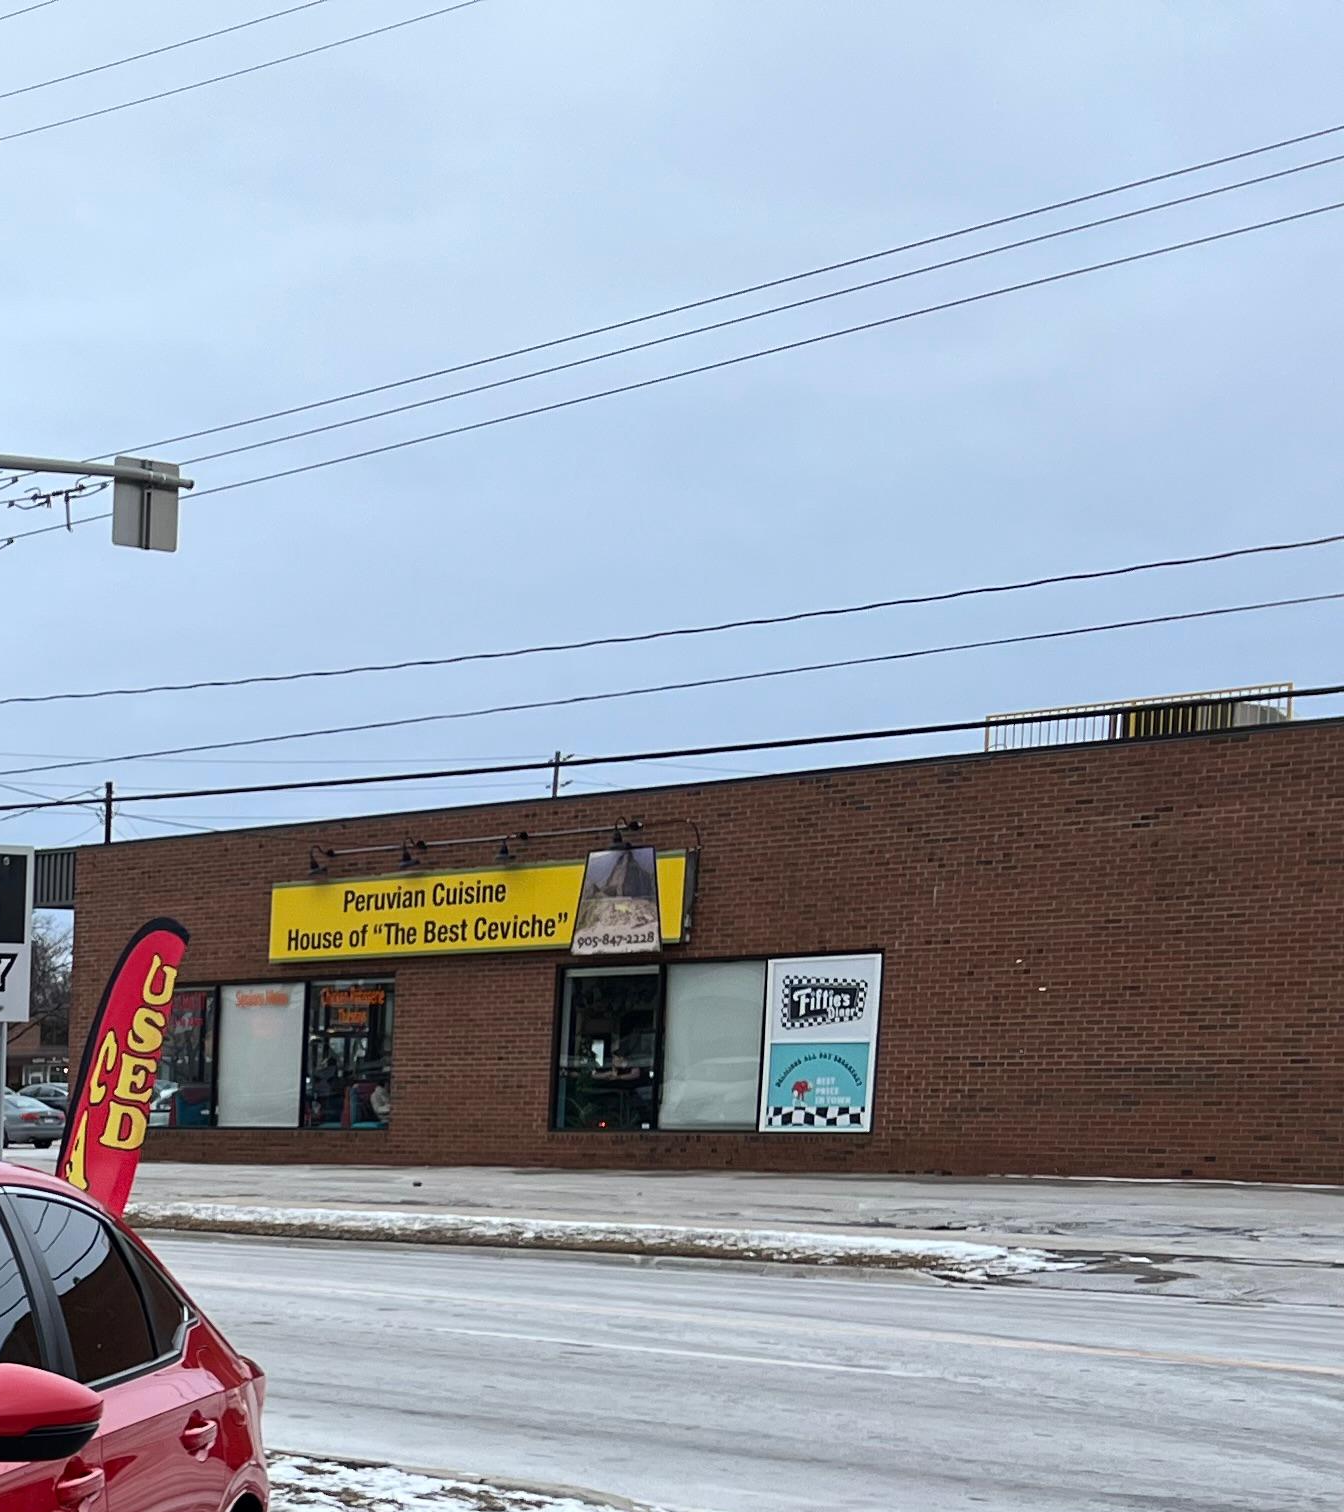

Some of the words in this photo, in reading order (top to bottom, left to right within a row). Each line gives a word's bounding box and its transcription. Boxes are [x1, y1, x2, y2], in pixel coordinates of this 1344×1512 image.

[343, 886, 426, 913] Peruvian
[432, 880, 507, 907] Cuisine
[287, 929, 344, 951] House
[348, 924, 369, 948] of
[423, 919, 468, 944] Best
[577, 932, 654, 949] 905-847-2228
[99, 953, 178, 1151] USED
